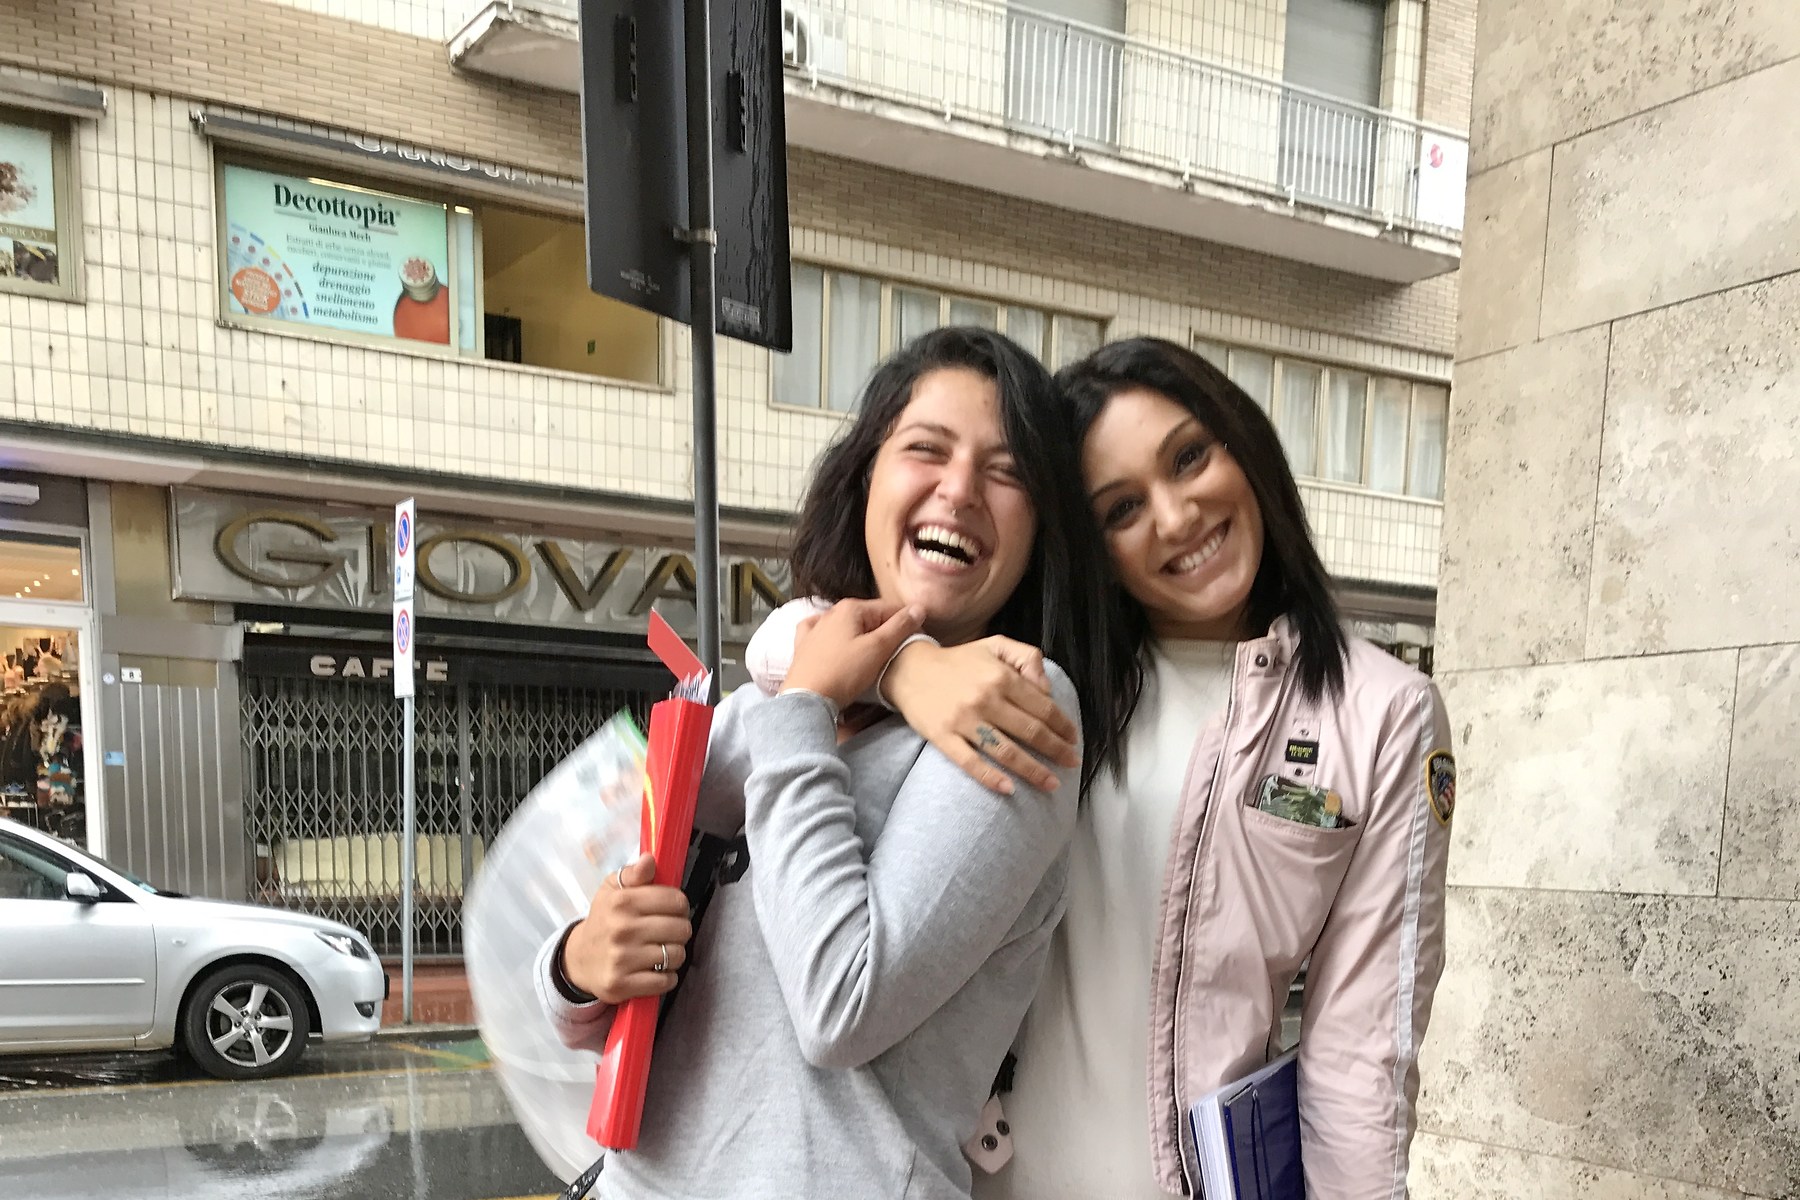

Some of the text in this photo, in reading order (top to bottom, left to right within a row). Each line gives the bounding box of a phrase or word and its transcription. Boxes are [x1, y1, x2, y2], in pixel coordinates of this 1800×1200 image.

[274, 184, 396, 229] Decottopia
[312, 261, 376, 281] depurazione
[319, 278, 371, 295] drenaggio
[315, 293, 375, 310] snellimento
[313, 307, 379, 325] metabolismo
[310, 655, 448, 682] CAFÈ
